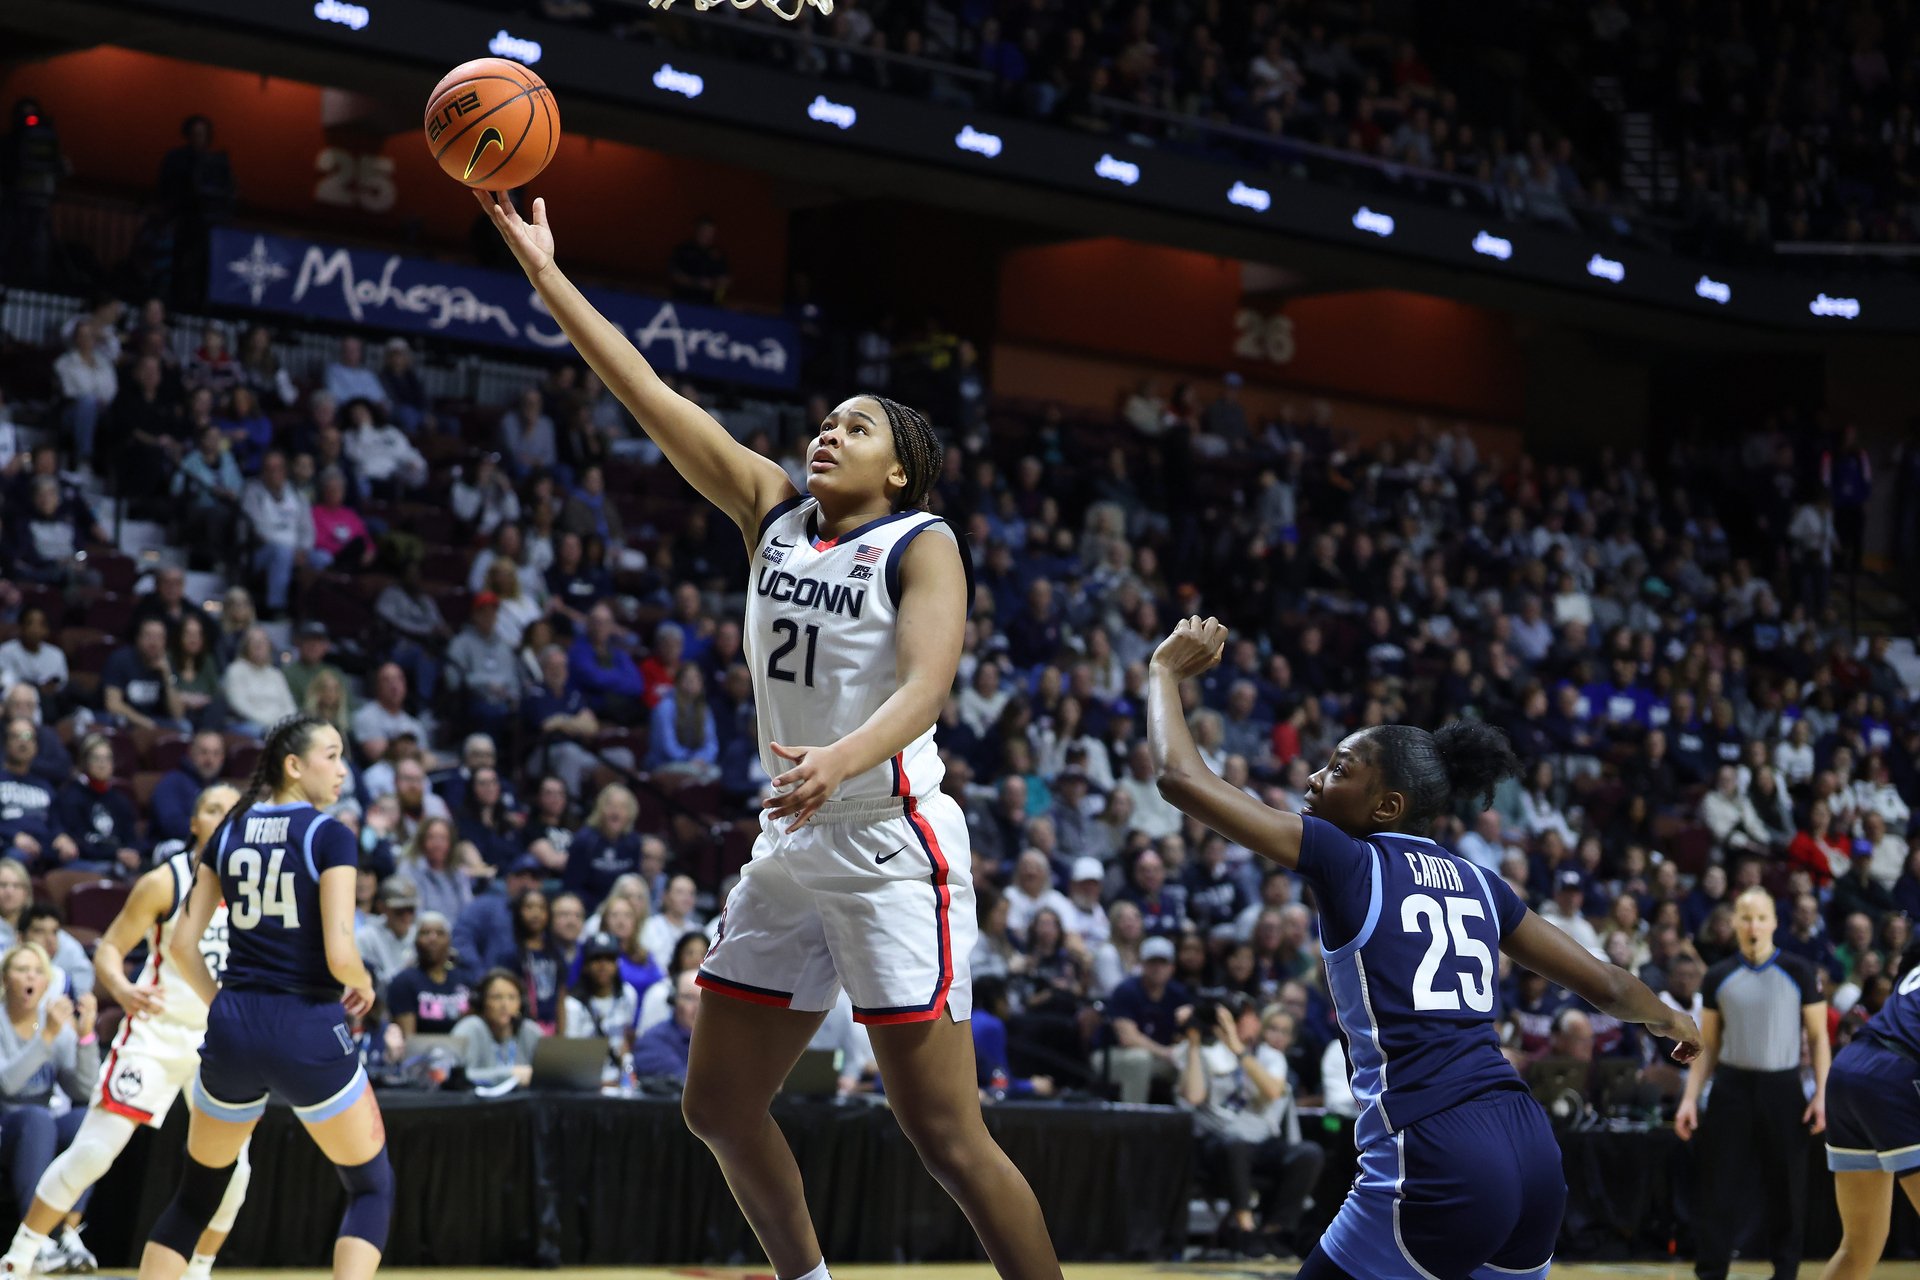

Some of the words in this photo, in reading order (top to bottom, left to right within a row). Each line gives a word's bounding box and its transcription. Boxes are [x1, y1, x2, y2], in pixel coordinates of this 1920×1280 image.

[314, 0, 370, 31] Jeep
[488, 30, 542, 66] Jeep
[652, 63, 704, 99] Jeep
[427, 90, 482, 144] ELITE
[807, 95, 857, 130] Jeep
[955, 125, 1003, 158] Jeep
[314, 149, 396, 212] 25
[1094, 153, 1140, 186] Jeep
[1227, 181, 1271, 212] Jeep
[1352, 206, 1395, 237] Jeep
[1472, 230, 1513, 260] Jeep
[1587, 254, 1625, 283] Jeep
[1695, 275, 1731, 304] Jeep
[292, 246, 519, 337] Mohegan
[636, 302, 788, 372] Arena
[1809, 293, 1860, 320] Jeep
[1233, 309, 1296, 364] 26
[761, 551, 783, 565] CHANGE
[764, 546, 774, 555] BE
[773, 549, 785, 558] THE
[854, 564, 871, 573] BIG
[848, 570, 873, 581] EAST
[757, 566, 866, 619] UCONN
[768, 618, 820, 688] 21
[228, 847, 301, 930] 34
[1404, 852, 1464, 892] CARTER
[1400, 894, 1494, 1013] 25
